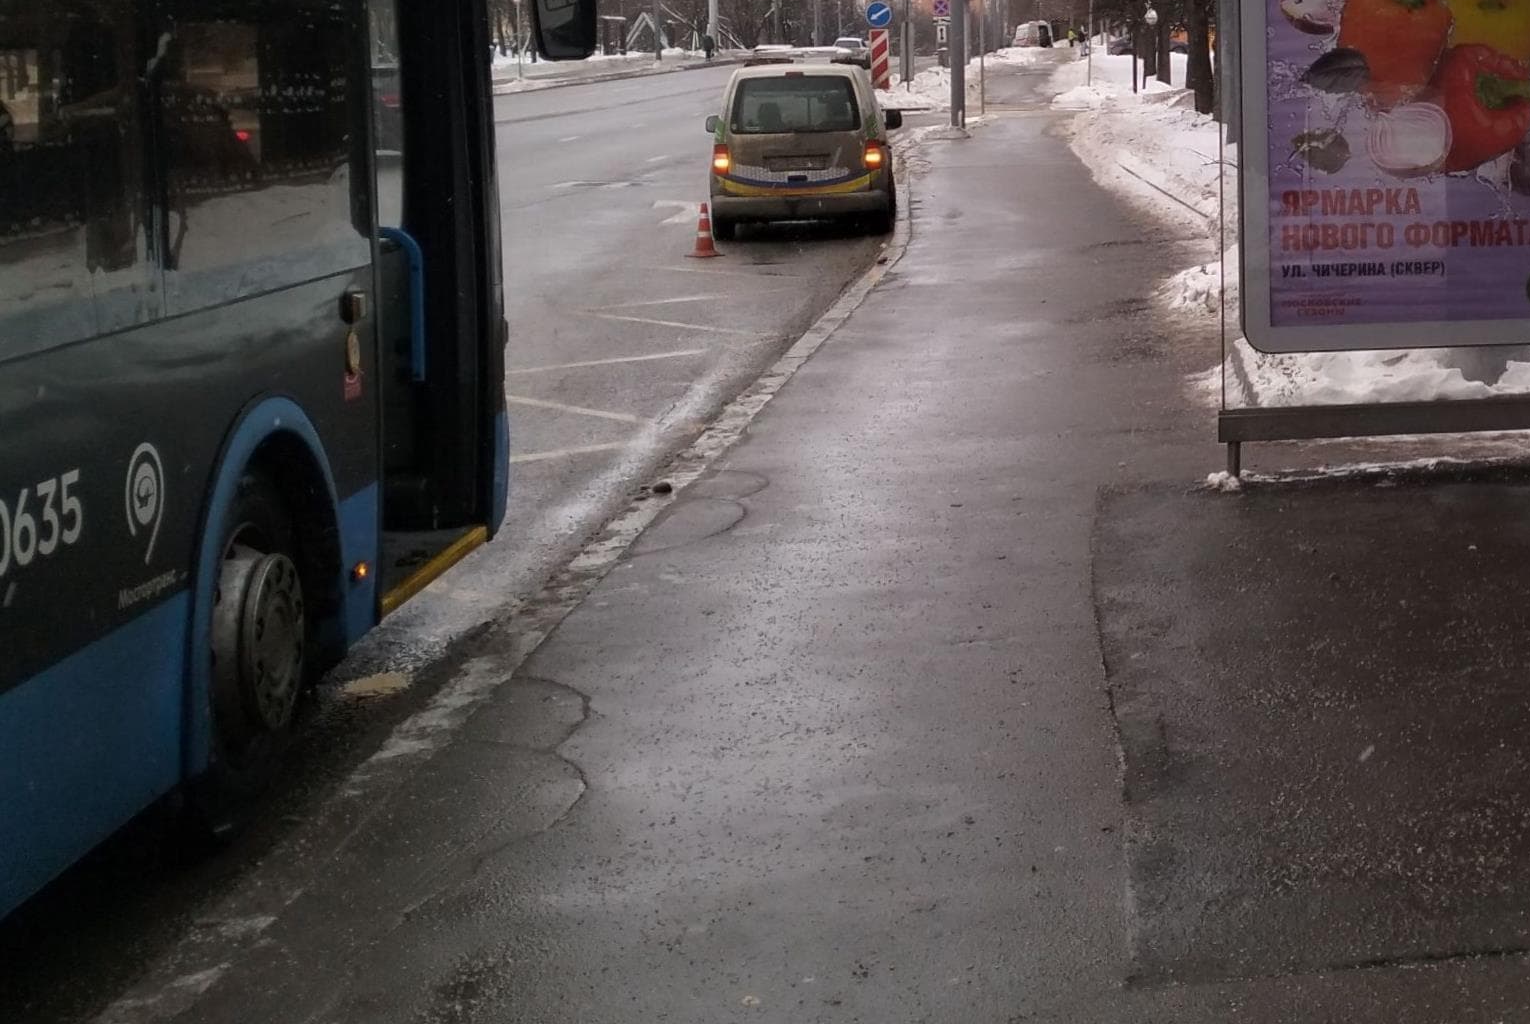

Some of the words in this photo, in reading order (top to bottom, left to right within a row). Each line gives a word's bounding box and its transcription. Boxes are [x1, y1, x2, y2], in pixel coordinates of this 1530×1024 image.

[1280, 187, 1421, 216] ЯРМАРКА
[1280, 222, 1394, 251] НОВОГО
[1281, 264, 1307, 278] УЛ.
[1312, 262, 1386, 277] ЧИЧЕРИНА
[1390, 260, 1446, 278] (СКВЕР)
